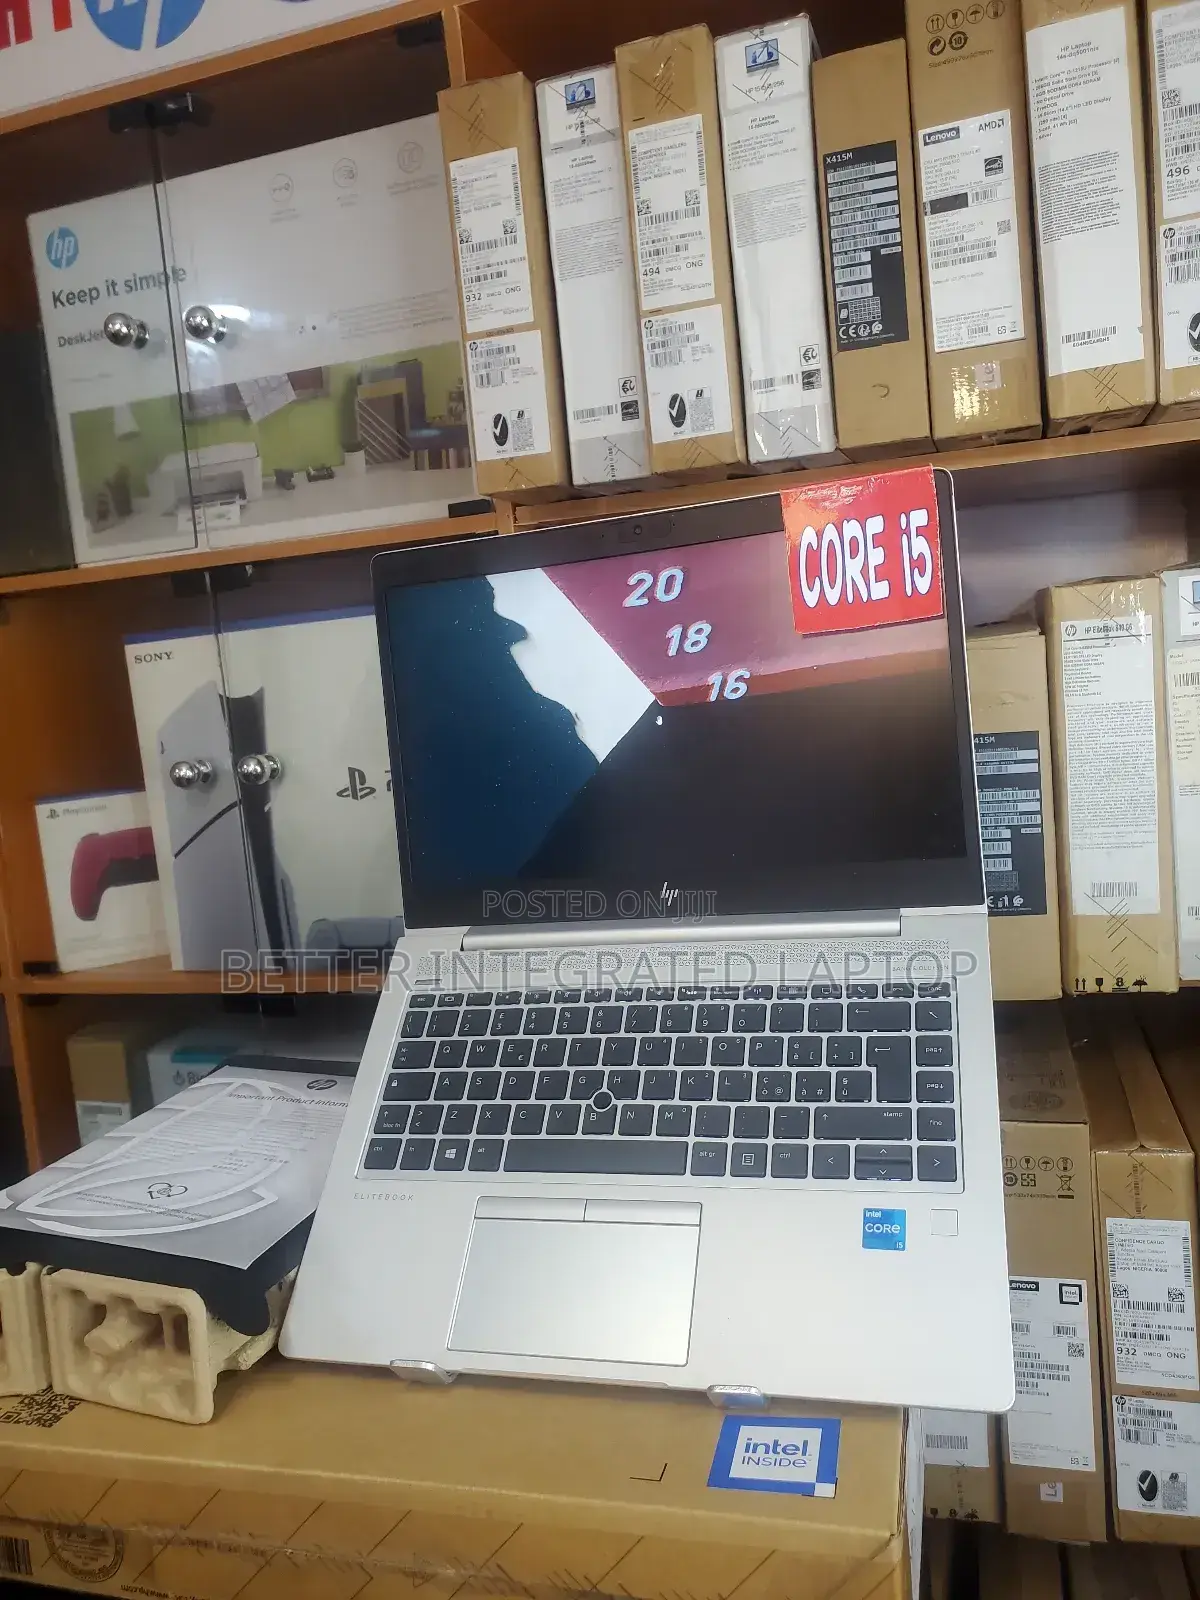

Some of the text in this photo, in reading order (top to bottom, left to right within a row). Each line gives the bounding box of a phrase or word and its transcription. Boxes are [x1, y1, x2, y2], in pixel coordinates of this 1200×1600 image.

[1071, 41, 1091, 50] Laptop
[978, 120, 998, 133] AMD
[926, 130, 957, 143] Lenovo
[826, 152, 853, 164] X415M
[1166, 165, 1190, 178] 496
[48, 227, 79, 268] hp
[643, 259, 703, 277] 494 ONG
[52, 265, 186, 309] Keep it simple
[465, 285, 522, 303] 932 ONG
[798, 507, 934, 609] CORE i5
[622, 565, 686, 608] 20
[665, 619, 713, 657] 18
[134, 651, 173, 664] SONY
[708, 667, 752, 702] 16
[464, 1023, 470, 1031] 2
[596, 1020, 602, 1028] 6
[443, 1045, 451, 1053] Q
[508, 1044, 515, 1052] E
[541, 1043, 548, 1051] R
[610, 1042, 618, 1050] Y
[645, 1042, 653, 1050] U
[756, 1042, 763, 1050] P
[442, 1077, 450, 1085] A
[475, 1077, 482, 1085] S
[509, 1076, 517, 1085] D
[543, 1076, 550, 1084] F
[578, 1076, 587, 1084] G
[613, 1076, 621, 1084] H
[648, 1076, 656, 1084] J
[687, 1077, 695, 1085] K
[724, 1077, 731, 1085] L
[774, 1087, 784, 1096] @
[816, 1088, 824, 1096] #
[228, 1092, 275, 1102] Important
[275, 1095, 316, 1106] Product
[450, 1110, 458, 1119] Z
[484, 1110, 492, 1119] X
[519, 1110, 527, 1119] C
[555, 1110, 563, 1119] V
[589, 1112, 597, 1121] B
[627, 1111, 635, 1120] N
[664, 1112, 674, 1120] M
[883, 1110, 903, 1118] stamp
[929, 1118, 943, 1126] fine
[779, 1151, 791, 1159] ctrl
[353, 1192, 414, 1201] ELITEBOOK
[865, 1210, 882, 1218] intel
[1116, 1346, 1186, 1360] 932 ONG
[744, 1437, 809, 1457] intel
